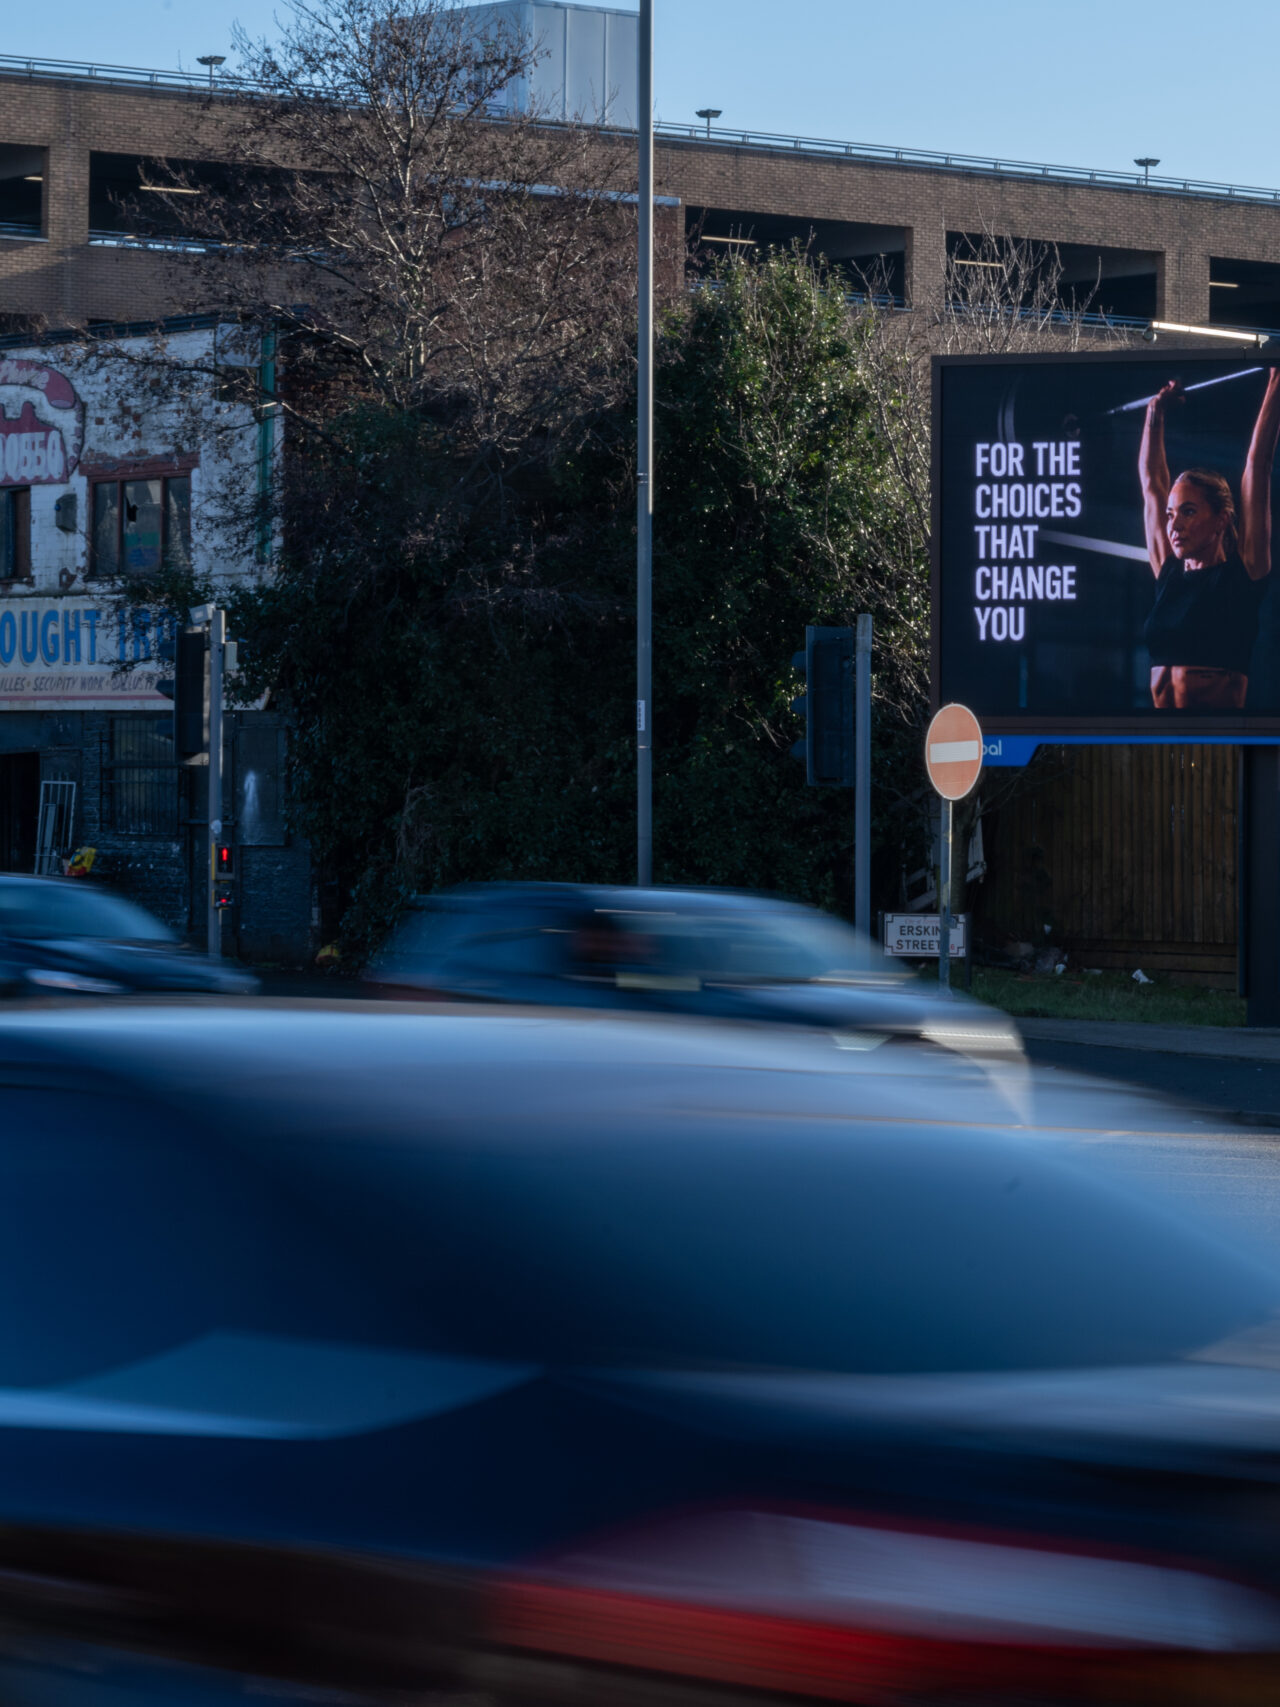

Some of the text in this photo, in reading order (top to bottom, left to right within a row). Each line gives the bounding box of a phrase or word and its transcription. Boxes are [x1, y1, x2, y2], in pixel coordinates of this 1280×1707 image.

[975, 441, 1081, 478] FOR THE
[975, 483, 1082, 519] CHOICES
[975, 525, 1039, 560] THAT
[975, 565, 1076, 601] CHANGE
[974, 607, 1025, 642] YOU
[899, 925, 941, 936] ERSKIN
